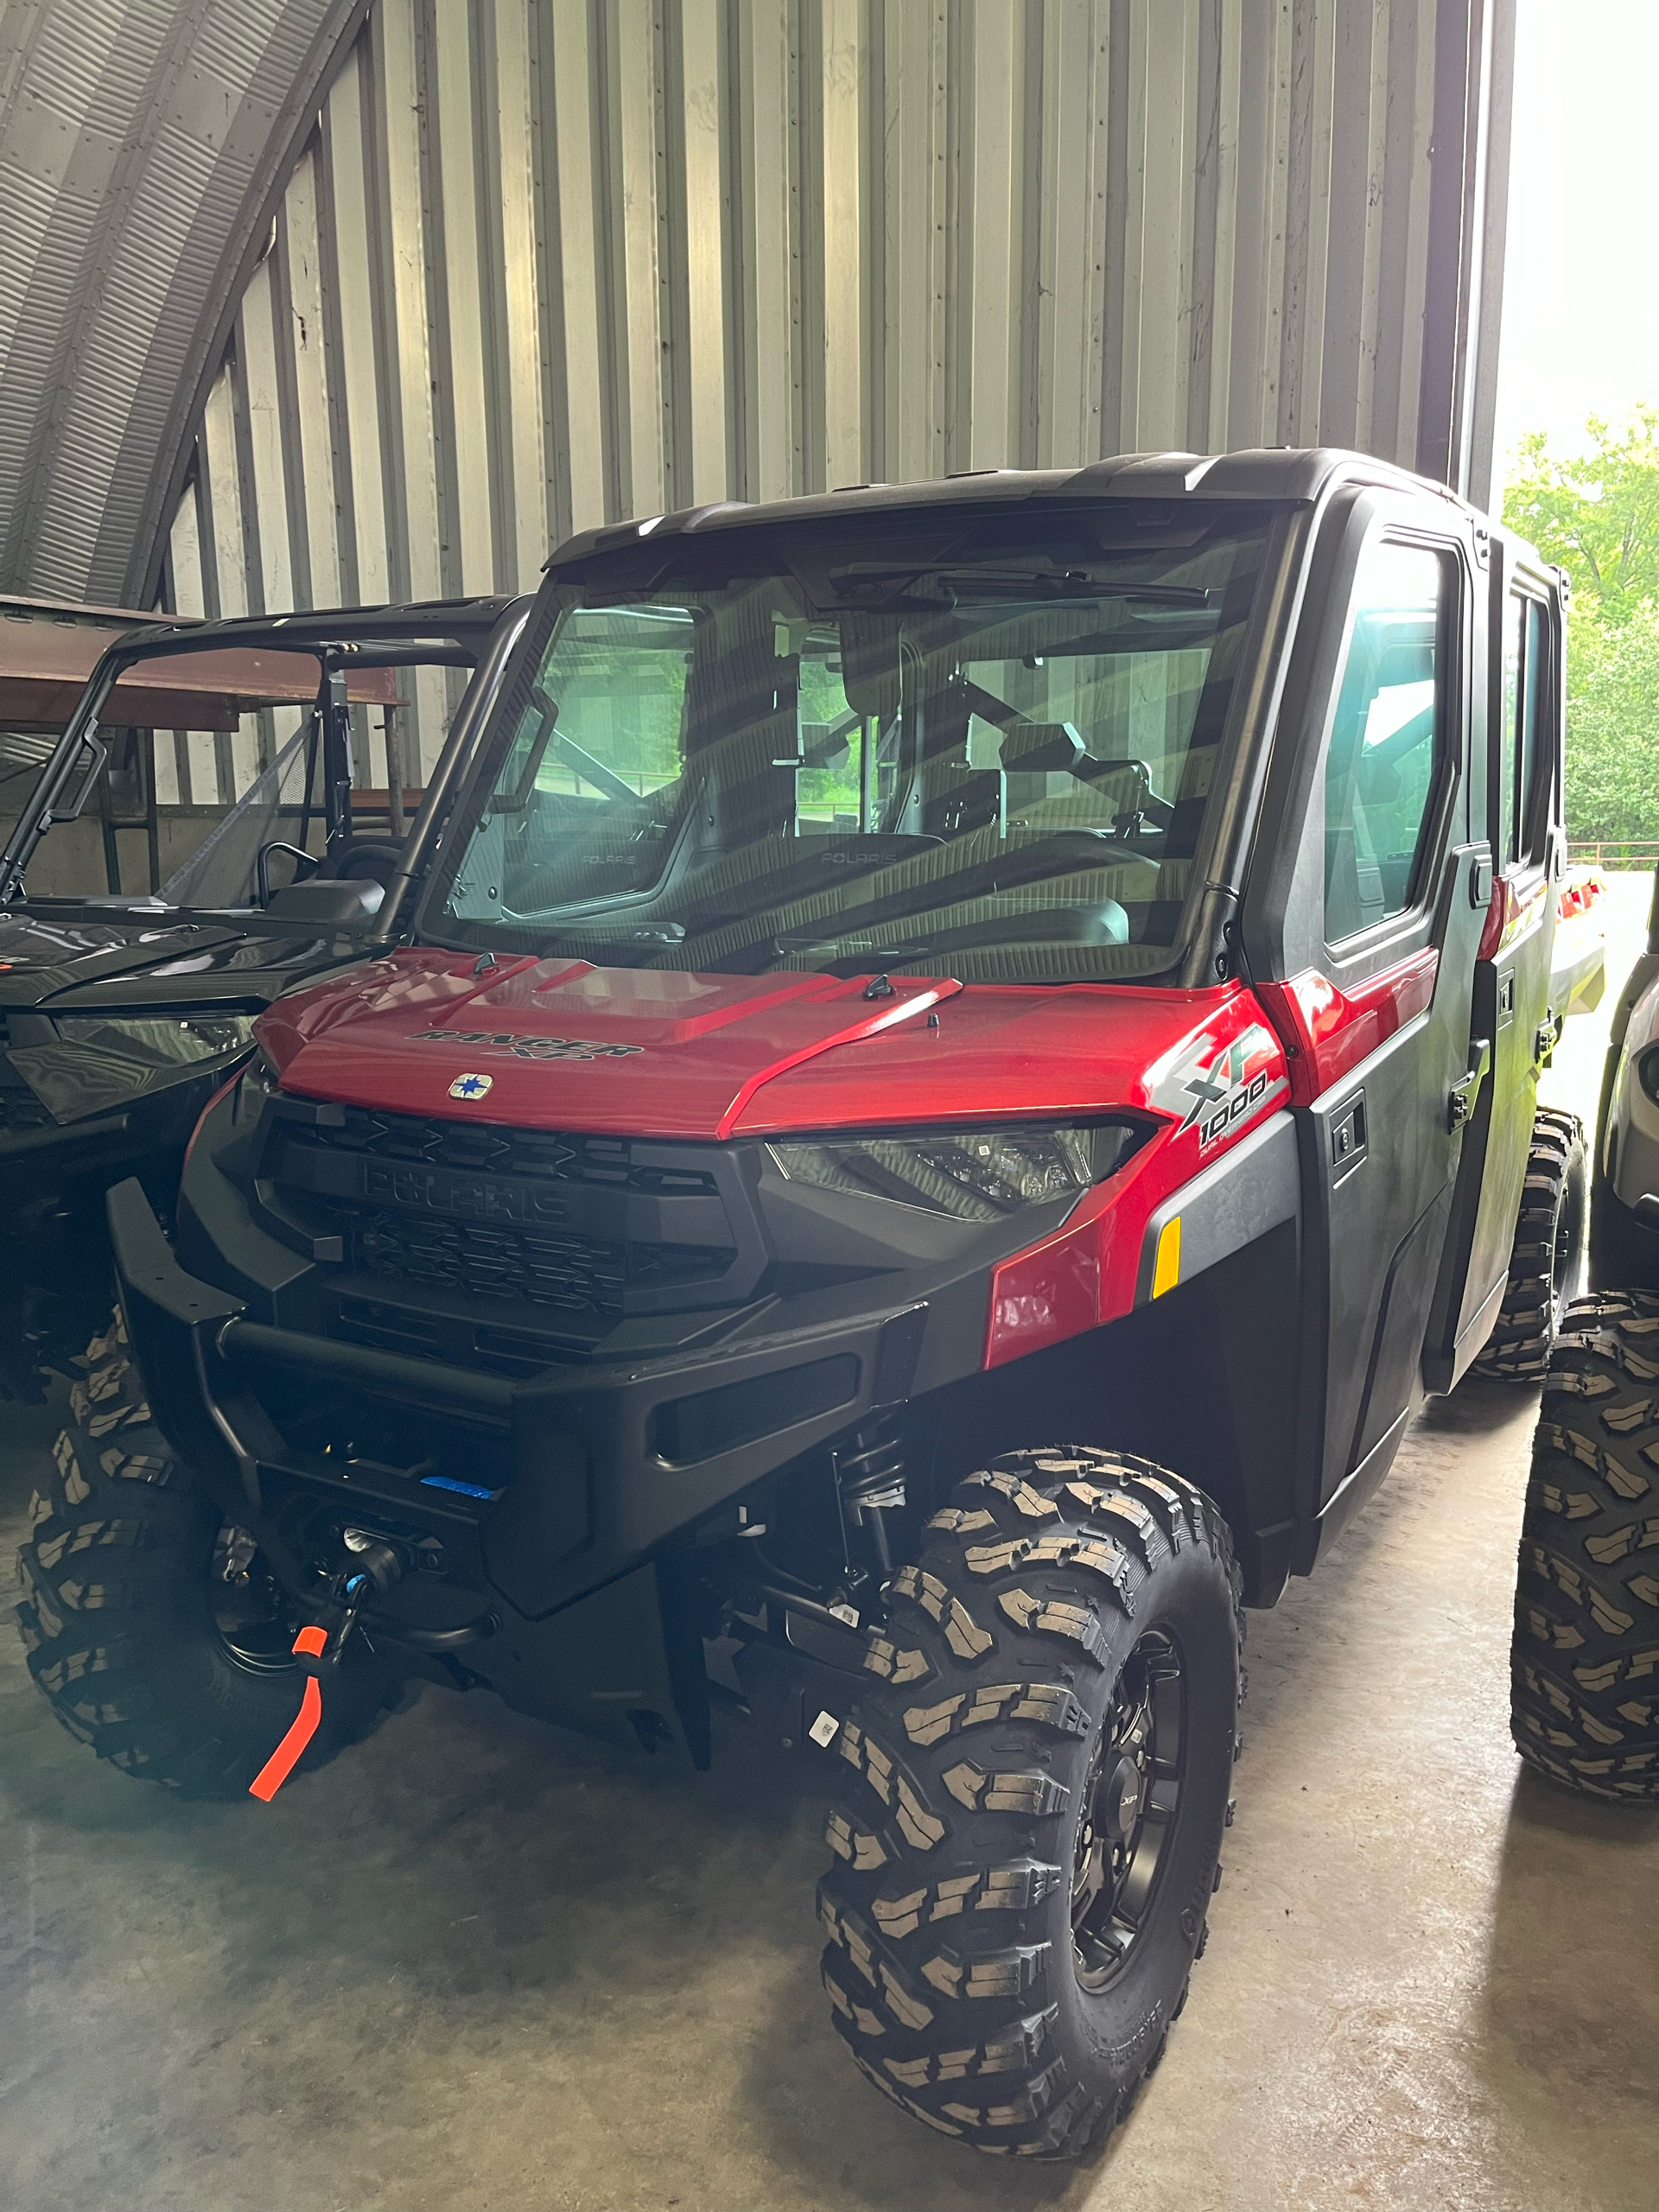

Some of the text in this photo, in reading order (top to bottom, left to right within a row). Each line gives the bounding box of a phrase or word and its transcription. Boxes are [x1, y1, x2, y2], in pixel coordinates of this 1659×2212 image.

[822, 853, 897, 864] POLARIS
[405, 1030, 645, 1057] RANGER
[480, 1046, 594, 1060] XP
[1198, 1068, 1268, 1150] 1000
[1199, 1140, 1218, 1160] DUAL
[364, 1164, 568, 1225] POLARIS
[1121, 1795, 1138, 1806] XP
